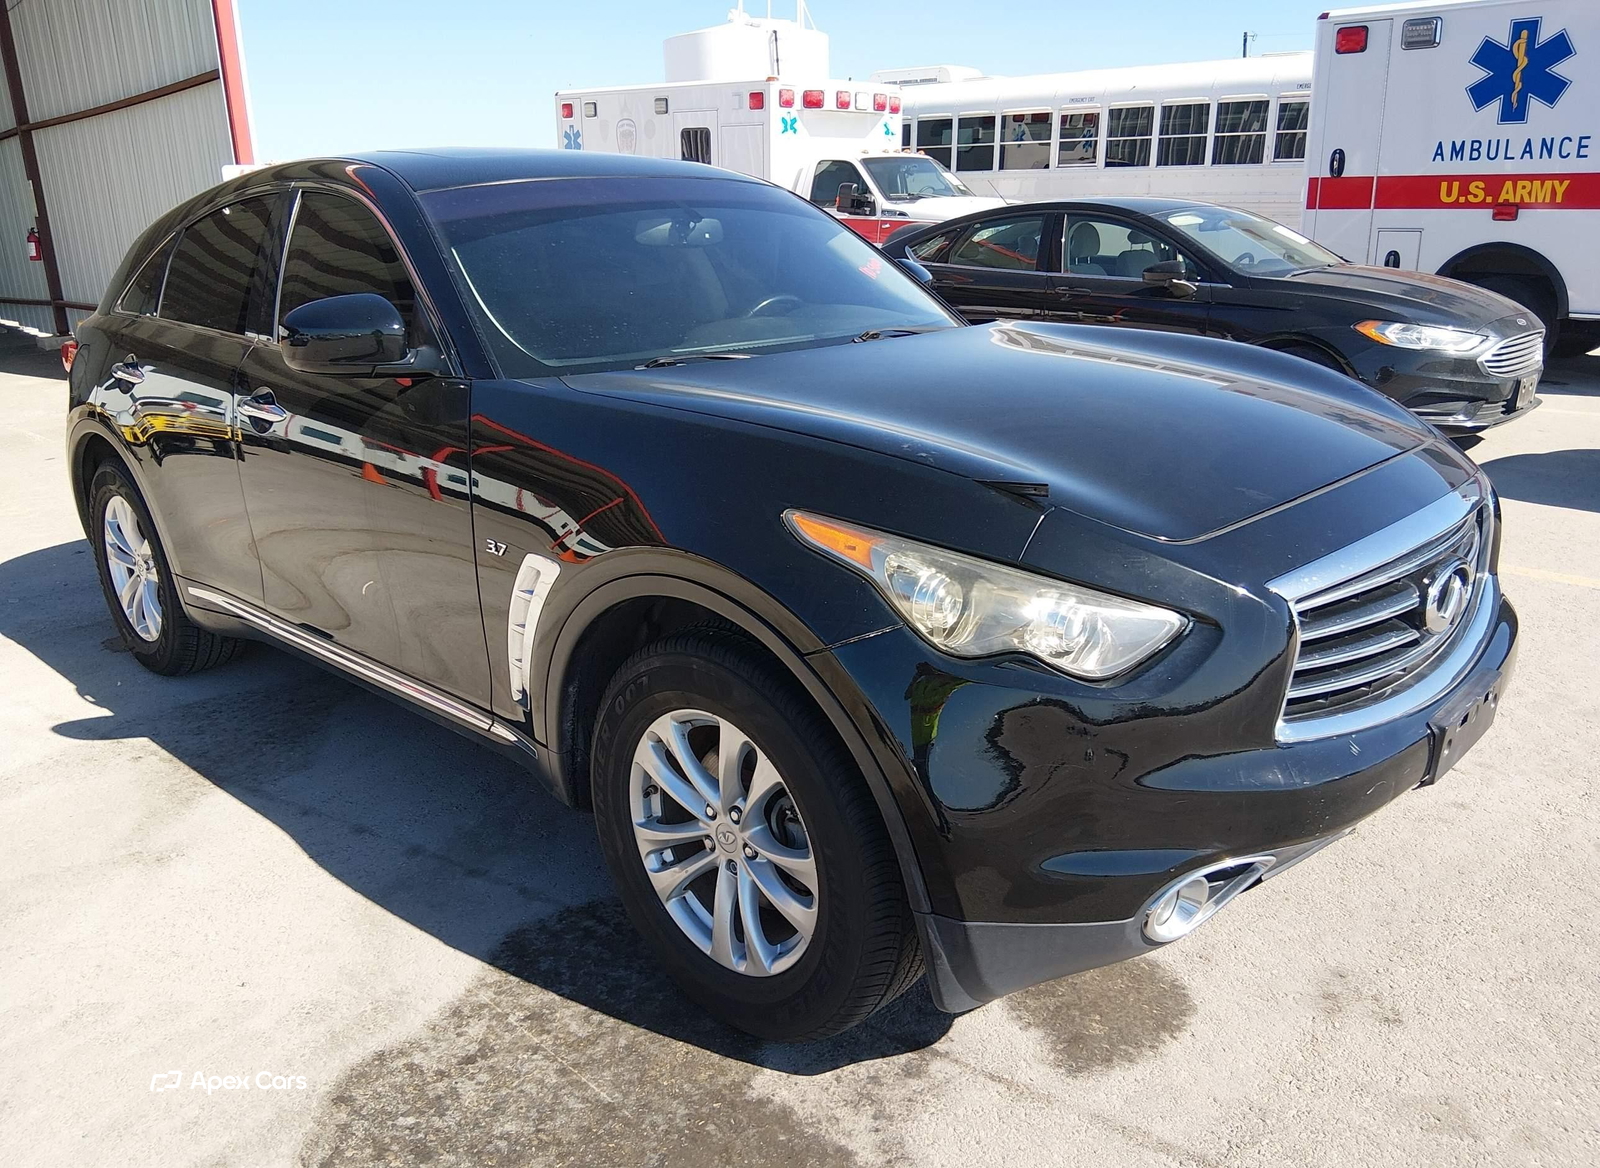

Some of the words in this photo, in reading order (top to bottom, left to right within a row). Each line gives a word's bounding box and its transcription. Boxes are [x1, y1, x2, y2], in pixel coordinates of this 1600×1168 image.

[1432, 136, 1591, 162] AMBULANCE
[1440, 181, 1493, 203] U.S.
[1499, 180, 1571, 203] ARMY
